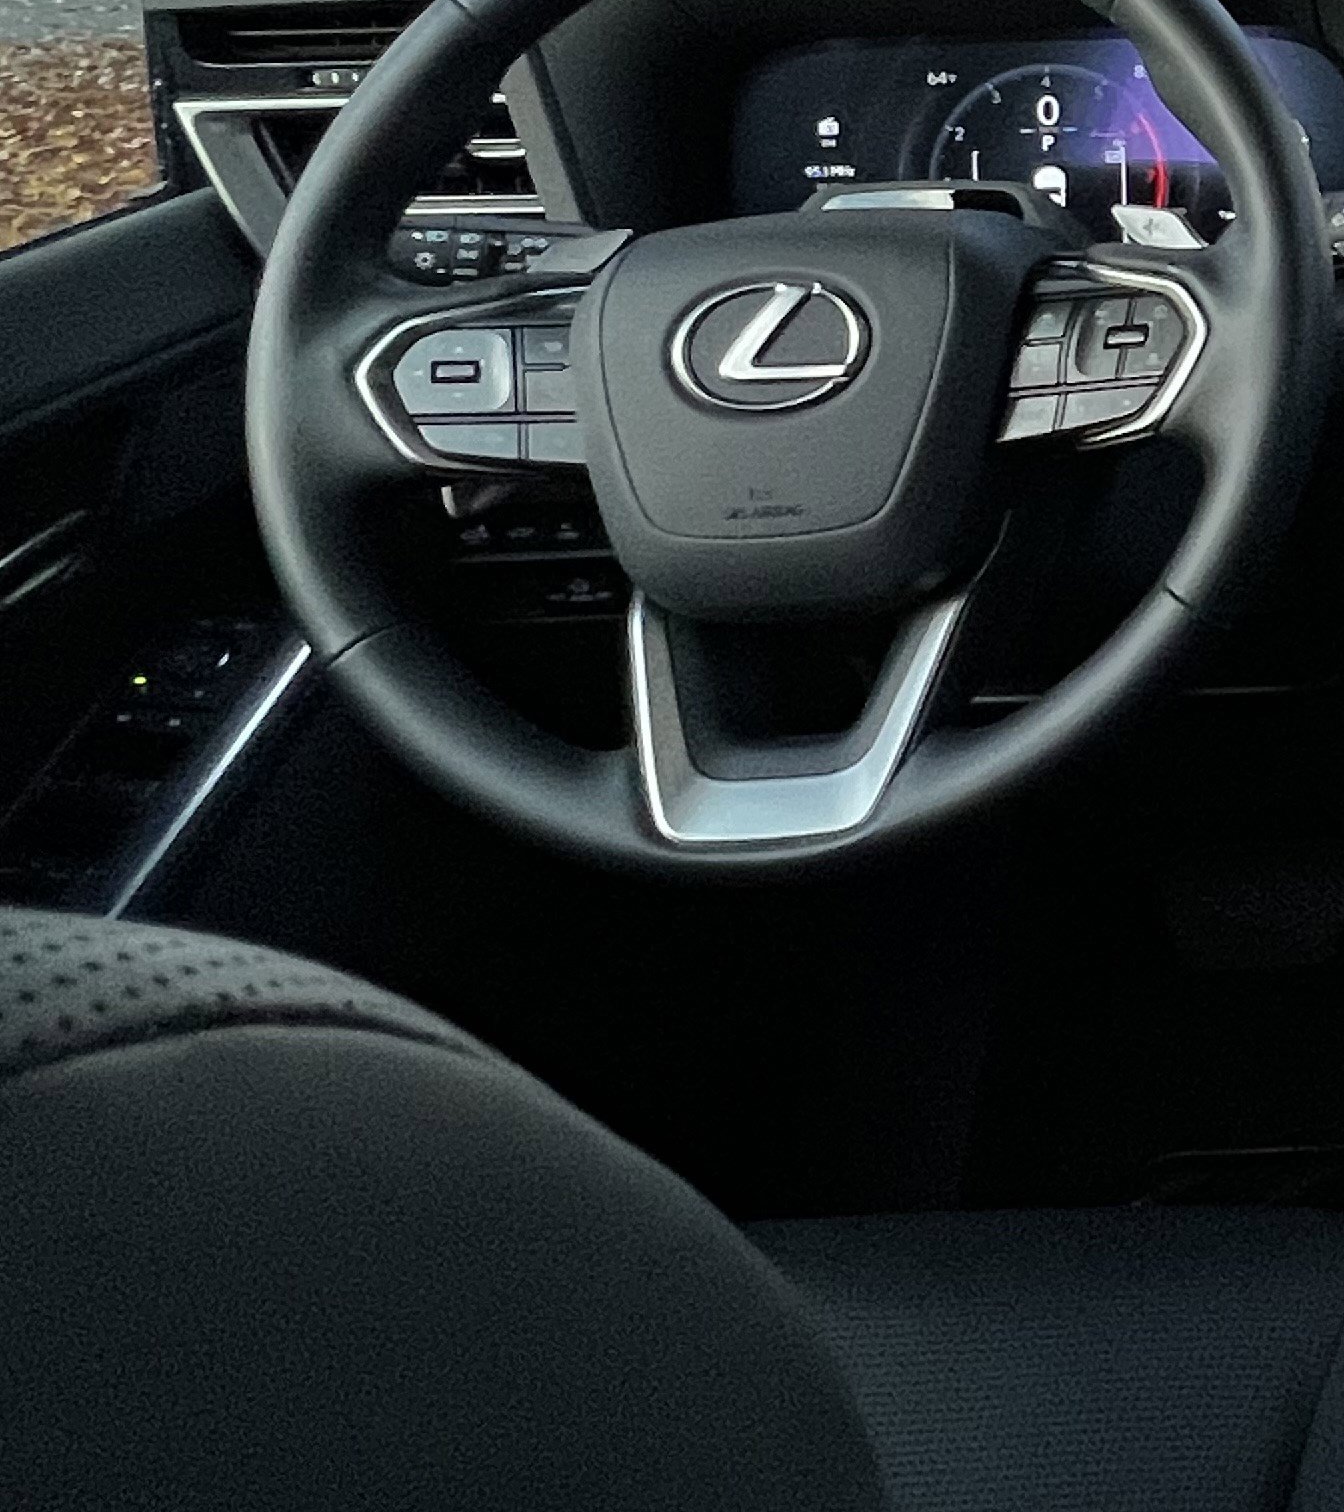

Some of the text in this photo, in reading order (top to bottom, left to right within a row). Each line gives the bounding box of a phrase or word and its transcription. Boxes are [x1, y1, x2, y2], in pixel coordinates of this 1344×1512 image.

[1040, 75, 1051, 88] 4
[1036, 93, 1060, 126] 0
[954, 126, 965, 142] 2
[1041, 134, 1055, 152] P
